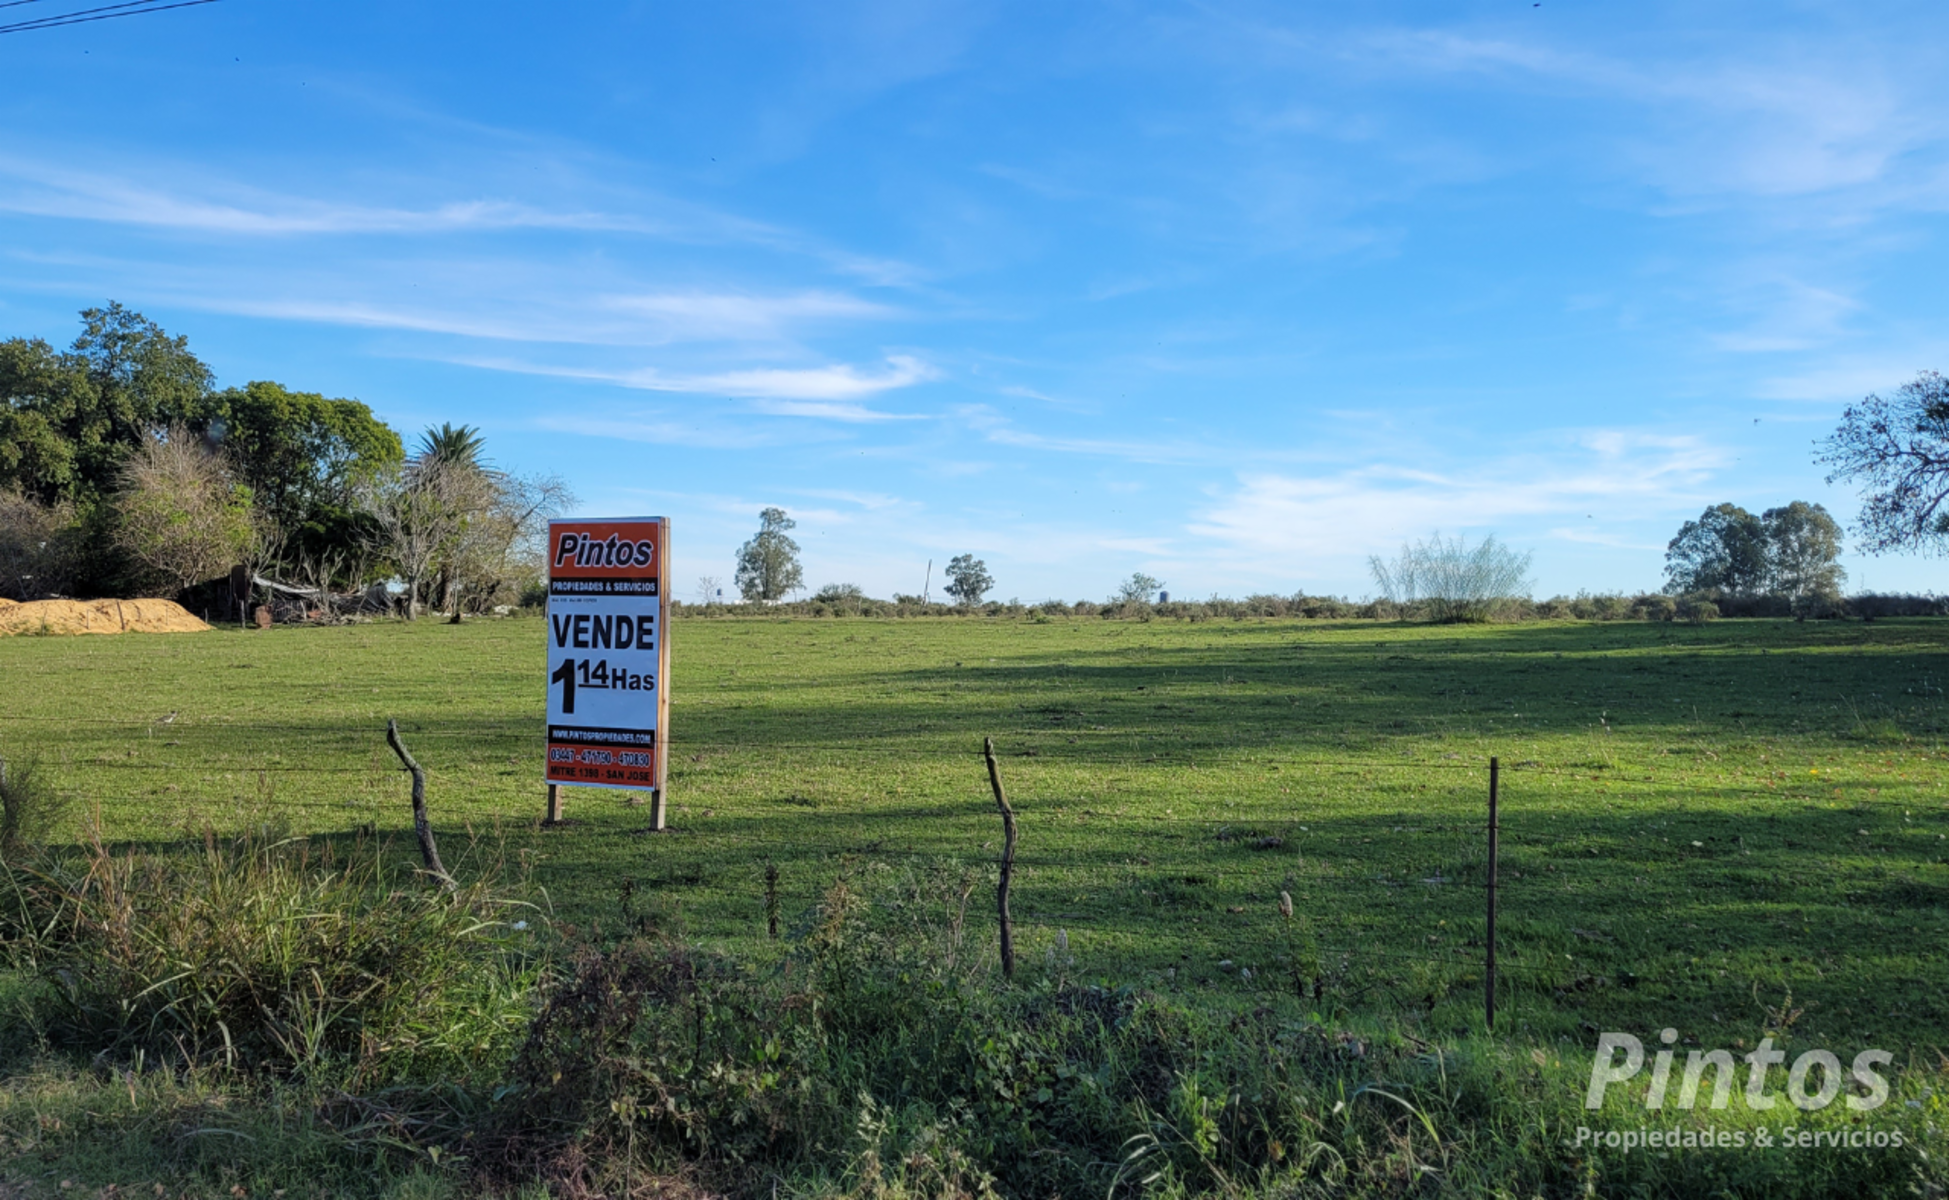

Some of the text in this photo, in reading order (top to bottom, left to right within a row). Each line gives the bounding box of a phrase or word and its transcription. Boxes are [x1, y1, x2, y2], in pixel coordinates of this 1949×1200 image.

[554, 532, 653, 567] Pintos
[552, 581, 655, 592] PROPIEDADES & SERVICIOS
[552, 614, 654, 650] VENDE
[612, 668, 655, 691] Has
[552, 730, 651, 744] WWW.PINTOSPROPIEDADES.COM
[550, 747, 575, 762] 03447
[618, 752, 650, 768] 470830
[550, 766, 576, 777] MITRE
[606, 769, 624, 780] SAN
[627, 771, 650, 781] JOSE
